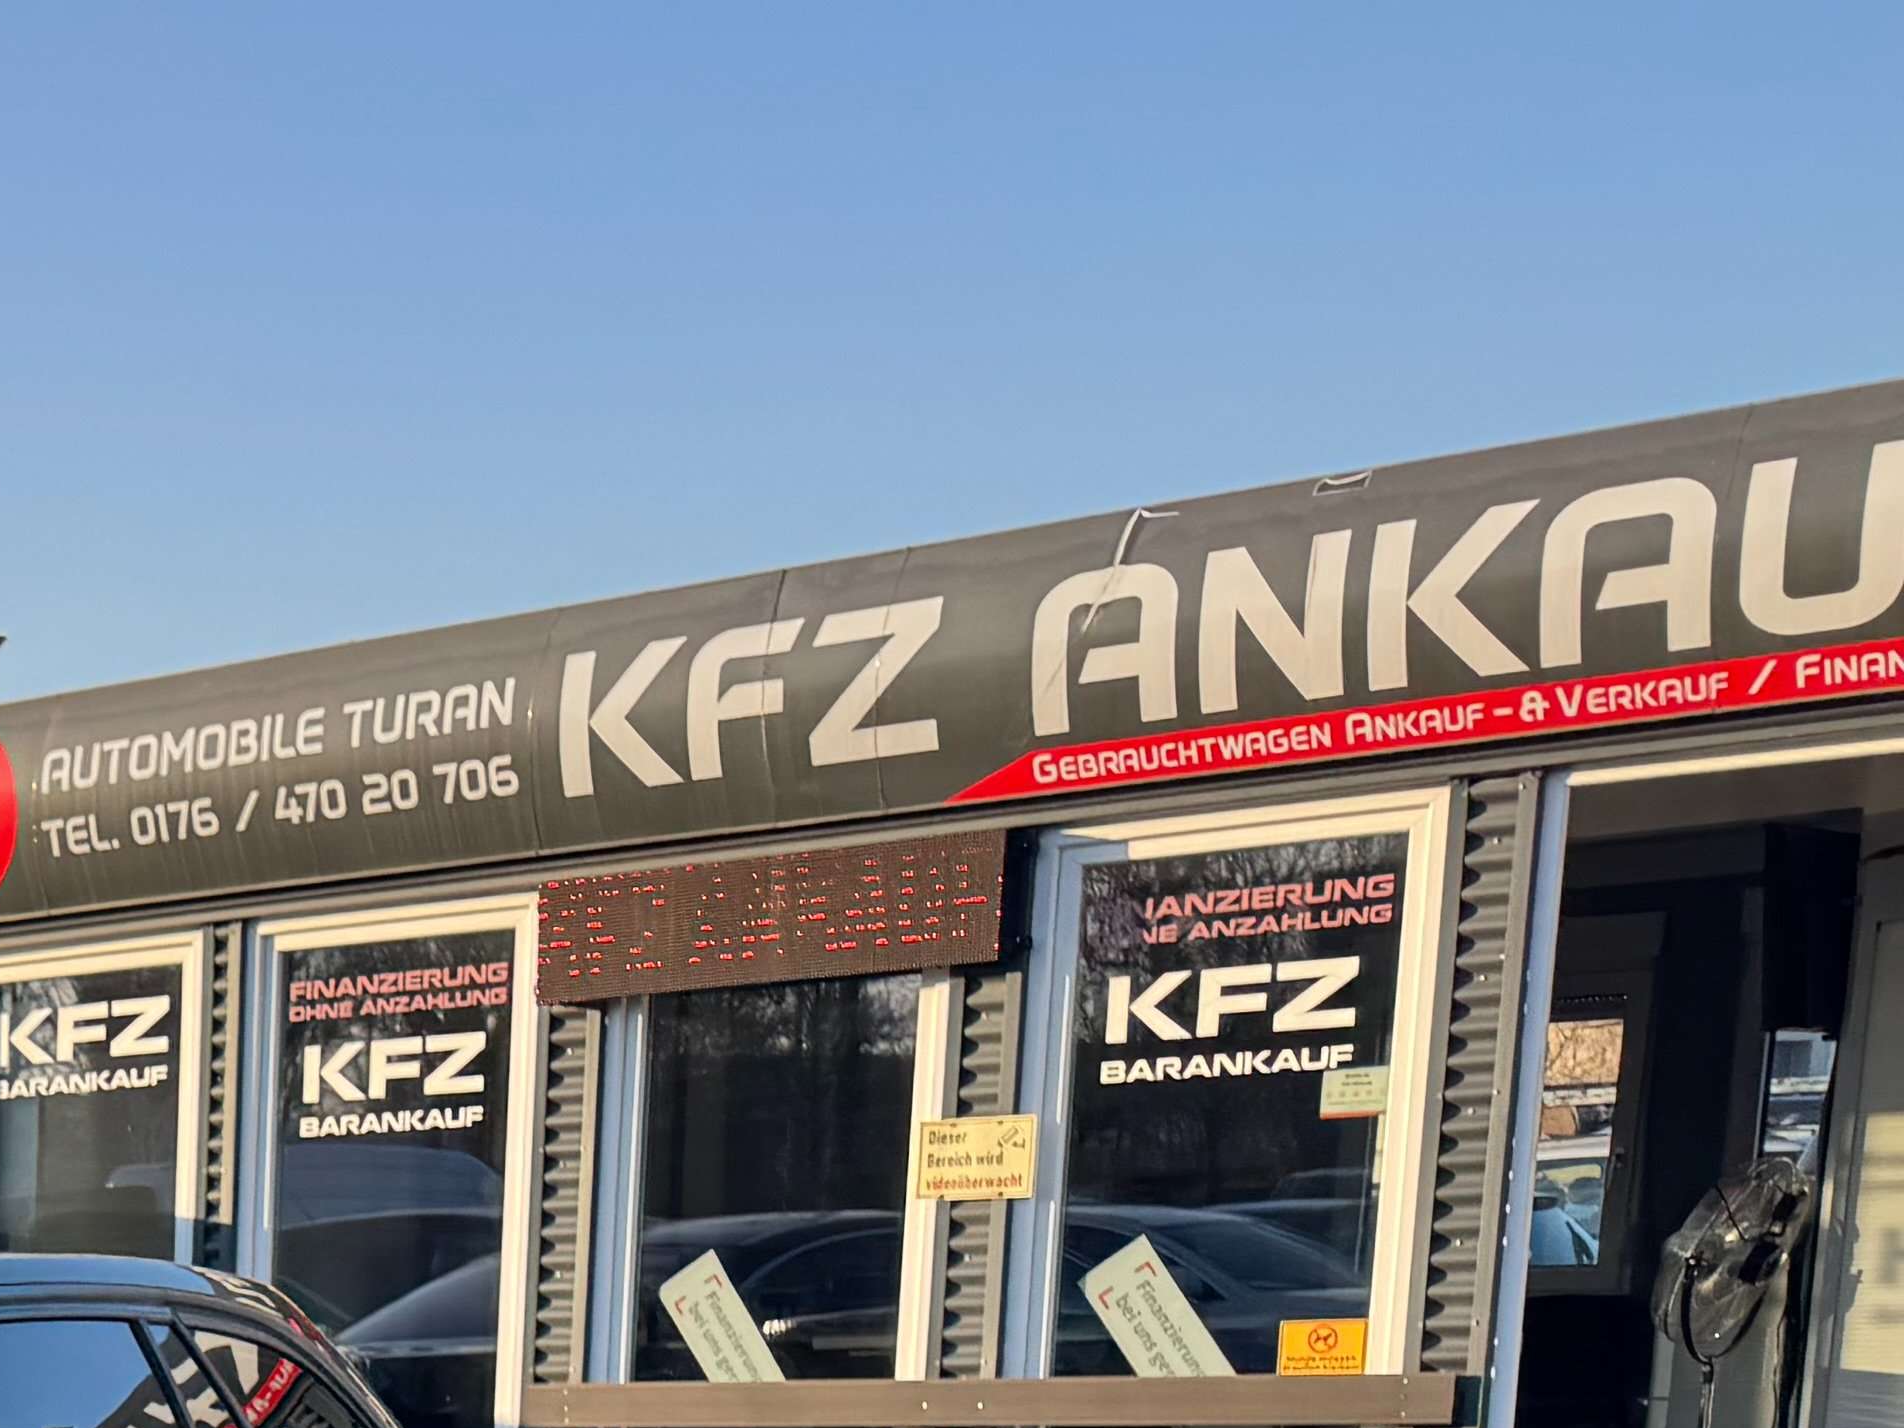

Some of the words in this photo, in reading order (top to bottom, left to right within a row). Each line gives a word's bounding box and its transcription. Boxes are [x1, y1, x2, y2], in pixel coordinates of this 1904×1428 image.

[558, 596, 944, 797] KFZ
[40, 706, 325, 794] AUTOMOBILE
[341, 677, 516, 749] TURAN
[1032, 721, 1333, 784] GEBRAUCHTWAGEN
[41, 812, 120, 858] TEL.
[130, 797, 220, 844] 0176
[274, 781, 348, 825] 470
[361, 768, 419, 815] 20
[432, 753, 520, 803] 706
[1187, 904, 1394, 941] ANZAHLUNG
[290, 962, 510, 1003] FINANZIERUNG
[1105, 956, 1360, 1045] KFZ
[289, 1002, 354, 1023] OHNE
[360, 988, 510, 1017] ANZAHLUNG
[302, 1031, 487, 1105] KFZ
[1100, 1044, 1355, 1085] BARANKAUF
[299, 1105, 484, 1139] BARANKAUF
[928, 1130, 967, 1146] Dieser
[927, 1152, 972, 1168] Bereich
[976, 1151, 1004, 1166] wird
[926, 1173, 1022, 1191] videoüberwacht
[1115, 1293, 1141, 1322] bei
[1133, 1322, 1158, 1352] uns
